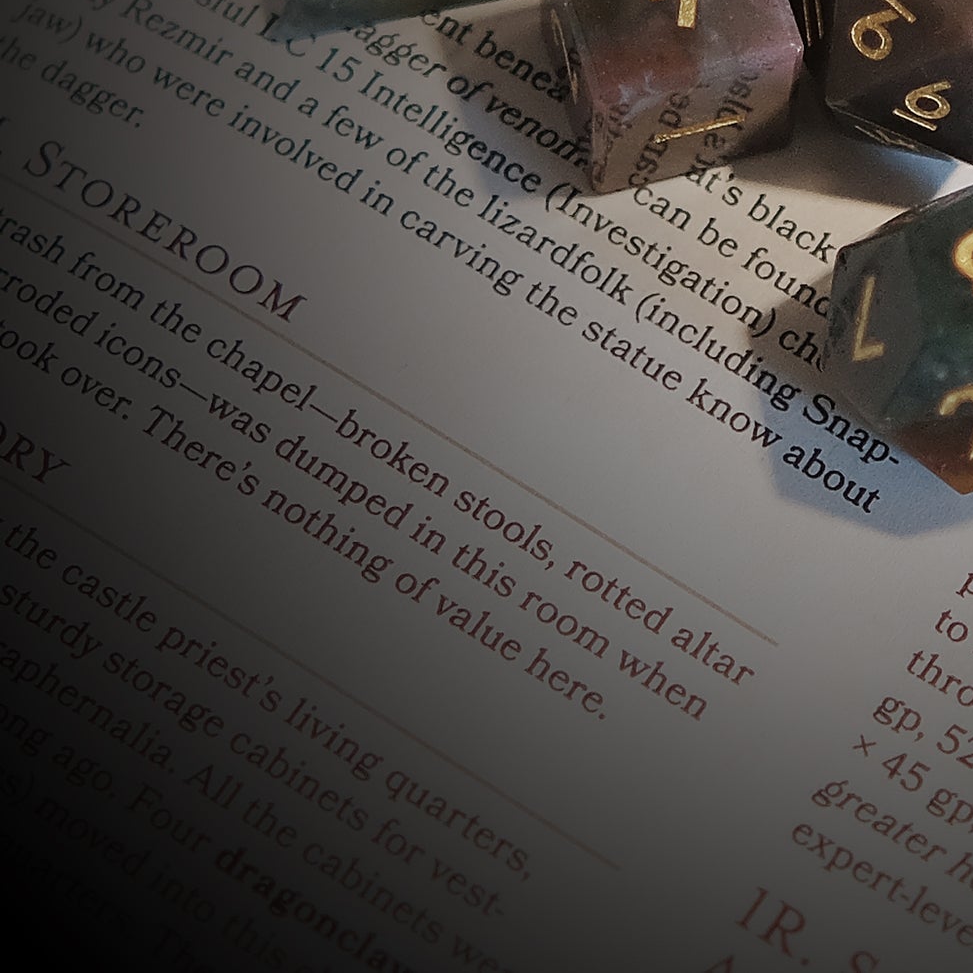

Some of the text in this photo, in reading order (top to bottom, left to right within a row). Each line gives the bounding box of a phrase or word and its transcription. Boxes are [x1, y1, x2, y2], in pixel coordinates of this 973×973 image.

[39, 59, 146, 129] dagger.
[314, 46, 363, 84] 15
[357, 68, 545, 196] Intelligence
[544, 177, 790, 344] (Investigation)
[9, 2, 882, 515] jaw) who were involved carving the statue know about
[233, 60, 302, 105] and
[320, 104, 386, 151] few
[422, 163, 476, 209] the
[475, 193, 635, 307] lizardfolk
[634, 291, 804, 413] (including
[801, 392, 901, 466] Snap-
[65, 250, 147, 313] from
[452, 489, 556, 572] stools,
[562, 559, 675, 636] rotted
[669, 627, 756, 686] altar
[141, 403, 606, 721] There's nothing value here.
[274, 434, 415, 532] dumped
[450, 543, 518, 599] this
[518, 590, 611, 660] room
[618, 648, 708, 722] when
[60, 563, 531, 881] castle priest's living quarters,
[100, 650, 506, 919] storage cabinets vest-
[810, 779, 948, 863] greater
